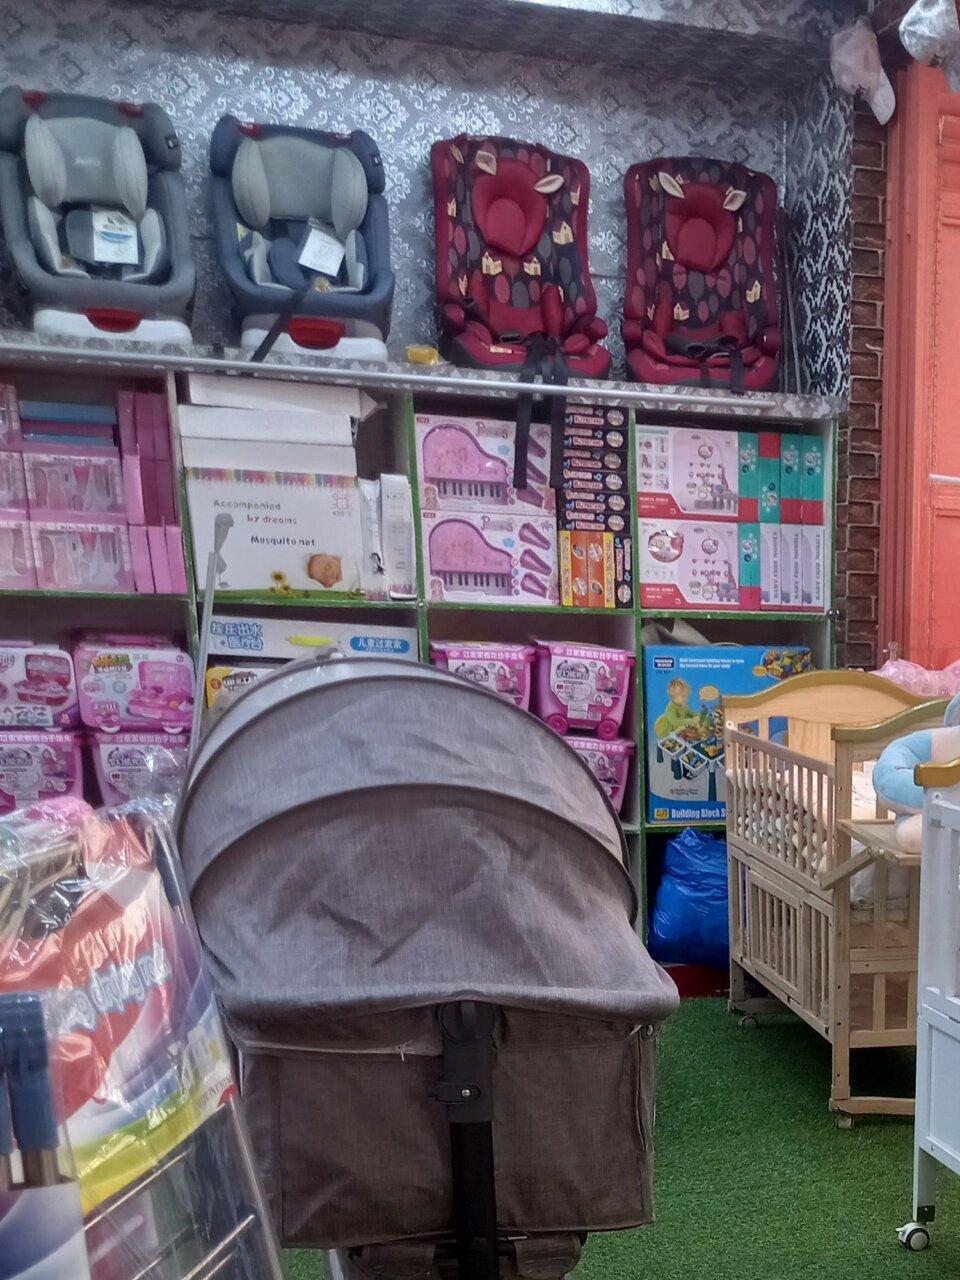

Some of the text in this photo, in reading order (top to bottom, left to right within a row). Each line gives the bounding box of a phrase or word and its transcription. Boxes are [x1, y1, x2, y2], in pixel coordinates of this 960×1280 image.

[213, 499, 281, 511] Accompanied
[246, 513, 298, 525] by dreams
[250, 535, 315, 547] Mosquito net
[671, 808, 700, 819] Building
[701, 807, 720, 818] Block
